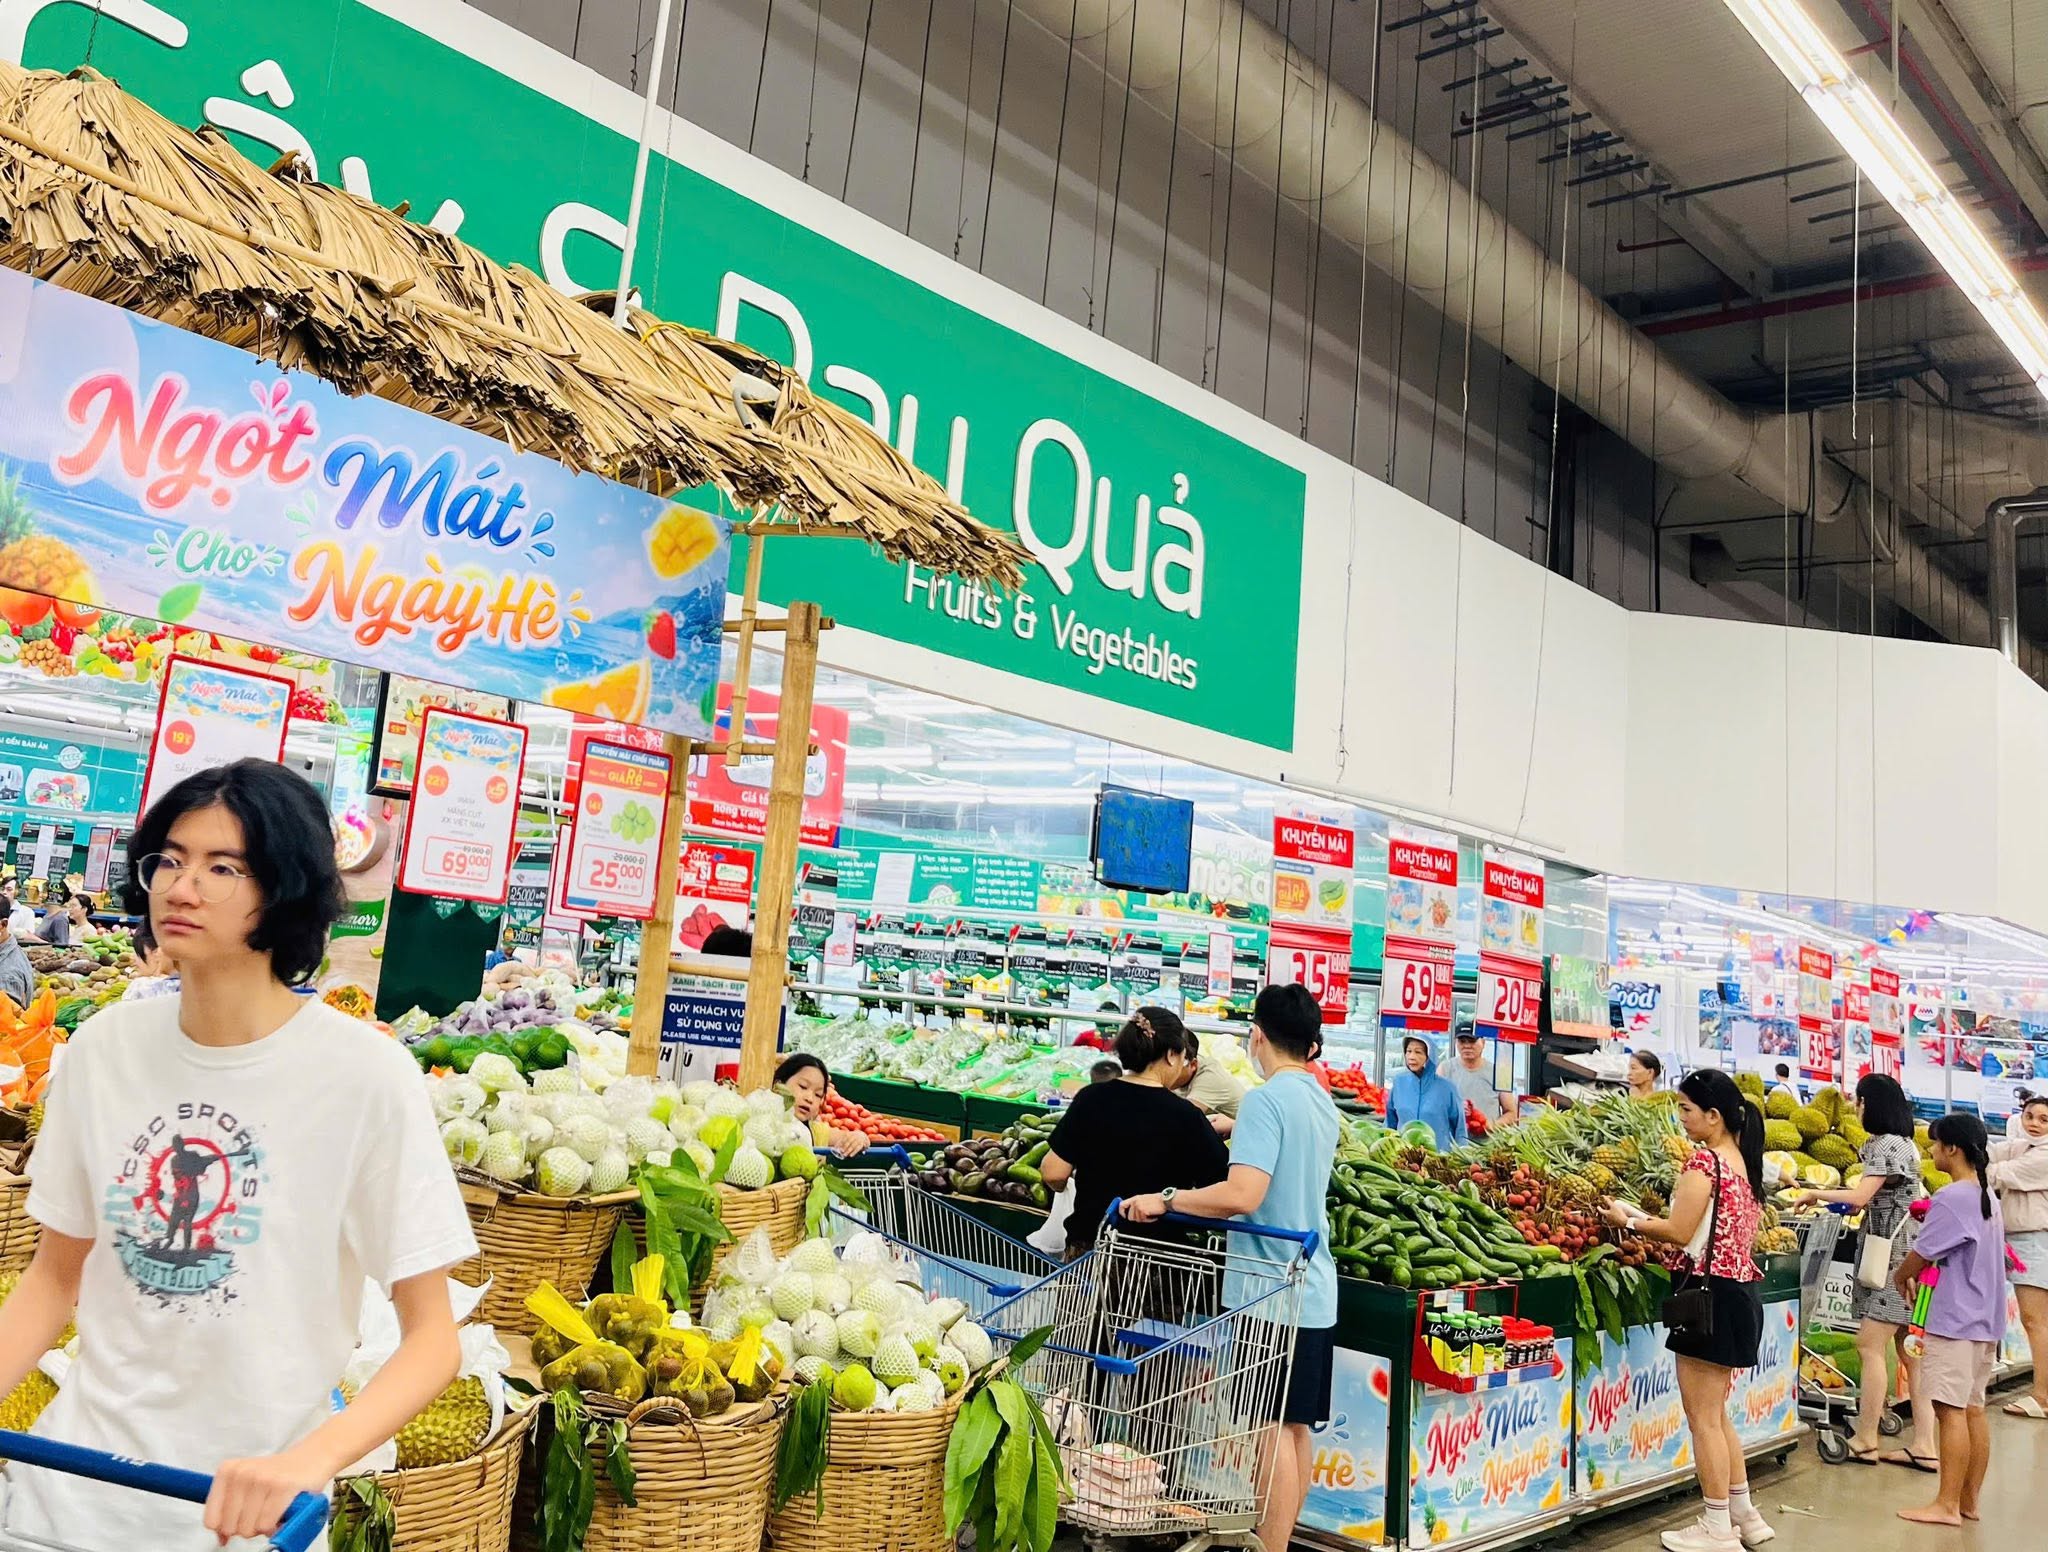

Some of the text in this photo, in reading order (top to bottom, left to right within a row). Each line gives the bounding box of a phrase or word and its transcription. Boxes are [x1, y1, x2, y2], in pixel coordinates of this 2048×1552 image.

[58, 374, 527, 546] Ngọt Mát
[1012, 418, 1206, 620] Quả
[176, 530, 560, 652] Cho Ngày Hè
[904, 558, 1198, 690] Fruits & Vegetables
[742, 790, 757, 804] Giá
[1282, 825, 1347, 854] KHUYẾN MÃI
[1298, 847, 1332, 862] Promotion
[442, 851, 489, 874] 69 000
[590, 858, 643, 888] 25 000
[1358, 855, 1386, 863] MARKE
[1395, 846, 1452, 872] KHUYẾN MÃI
[1409, 866, 1438, 881] Promotion
[1489, 868, 1539, 895] KHUYẾN MÃI
[672, 976, 696, 987] XANH
[1293, 951, 1327, 1002] 35
[1402, 964, 1433, 1010] 69
[669, 1001, 690, 1013] QUÝ
[693, 1004, 728, 1017] KHÁCH
[1494, 978, 1521, 1022] 20
[662, 1030, 686, 1039] PLEASE
[677, 1016, 743, 1033] SỬ DỤNG VỪ
[177, 1103, 259, 1198] SPORTS
[1825, 1281, 1840, 1294] Củ
[1588, 1357, 1671, 1434] Ngọt Mát
[1427, 1385, 1539, 1477] Ngọt Mát
[1629, 1411, 1665, 1460] Ngày
[1312, 1448, 1356, 1487] Hè
[1455, 1438, 1549, 1505] Cho Ngày Hè
